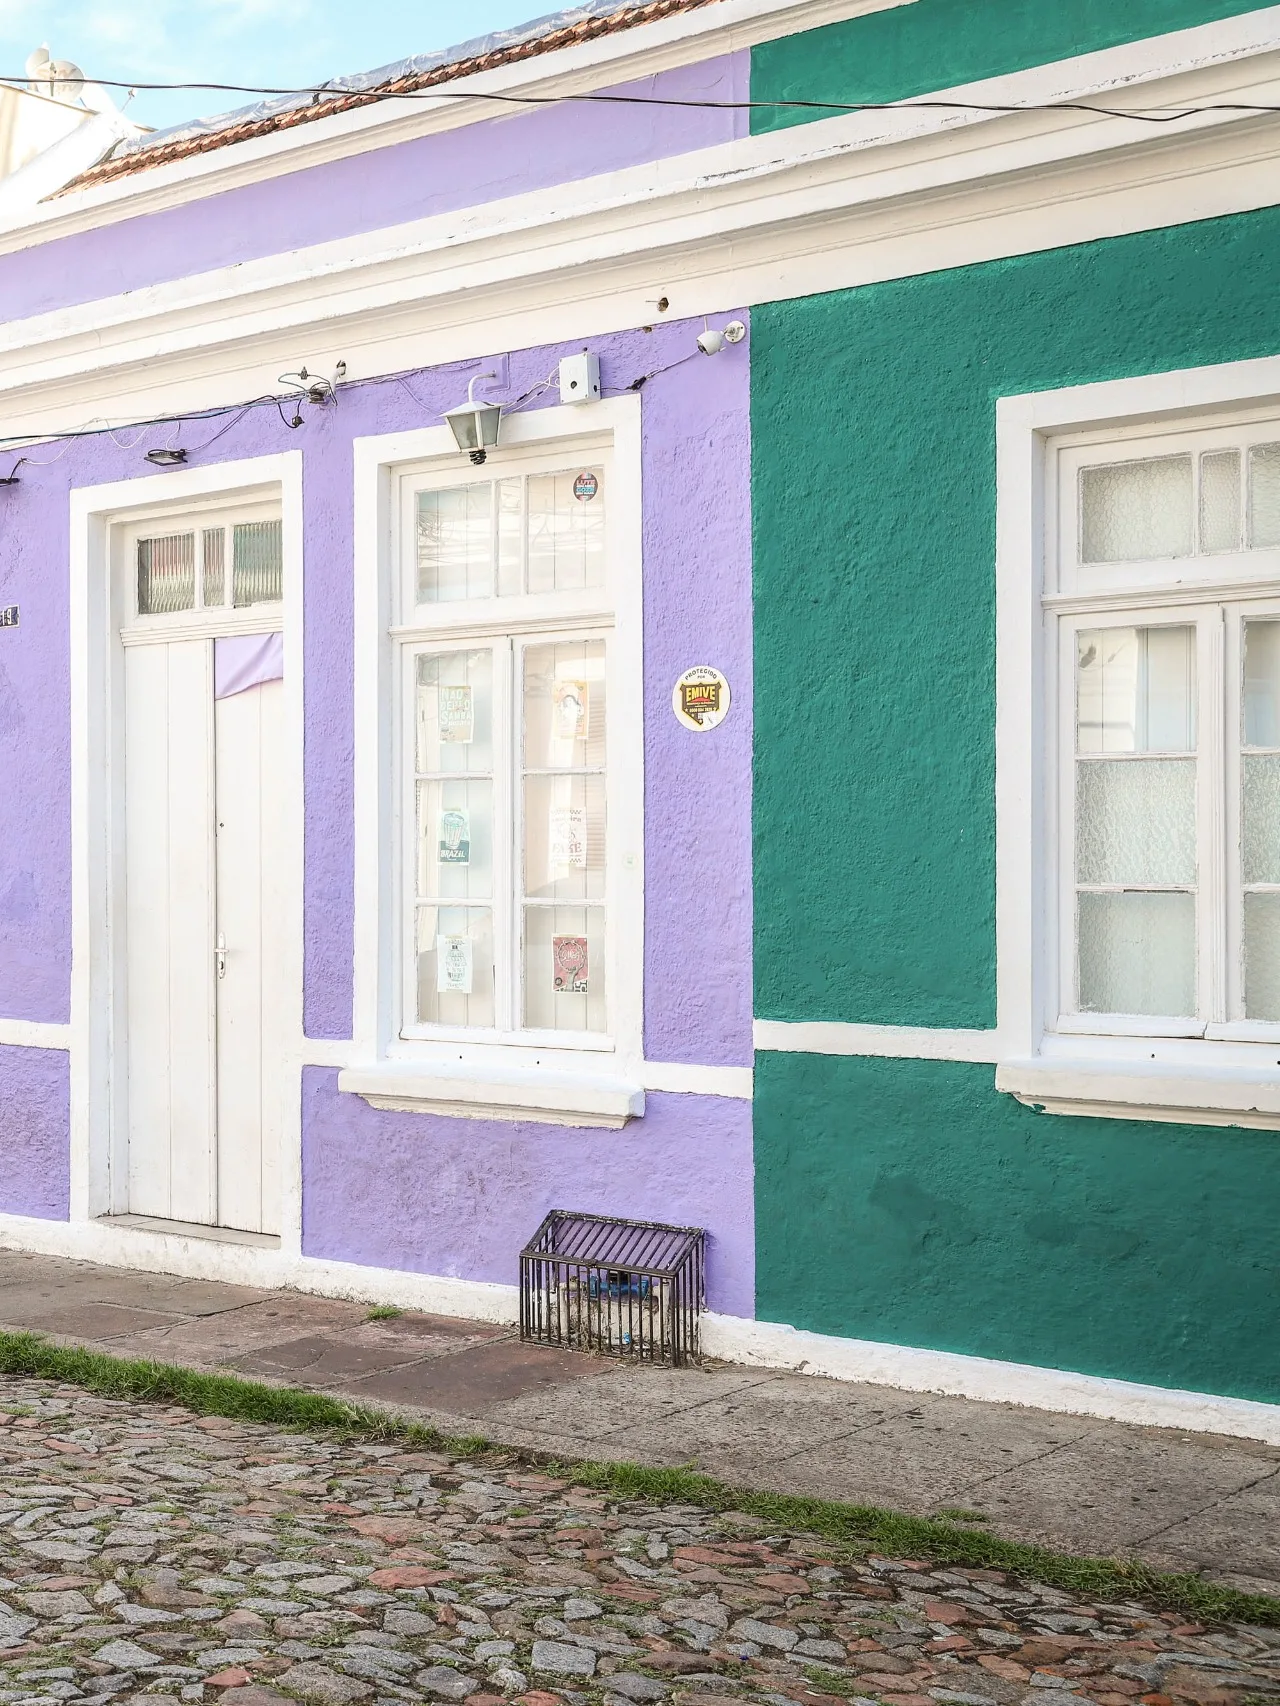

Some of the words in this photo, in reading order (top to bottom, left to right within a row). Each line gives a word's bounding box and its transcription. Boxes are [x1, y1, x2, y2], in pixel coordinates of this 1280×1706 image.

[0, 608, 12, 626] 19
[684, 668, 718, 681] PROTEGIDO
[685, 685, 716, 702] EMIVE
